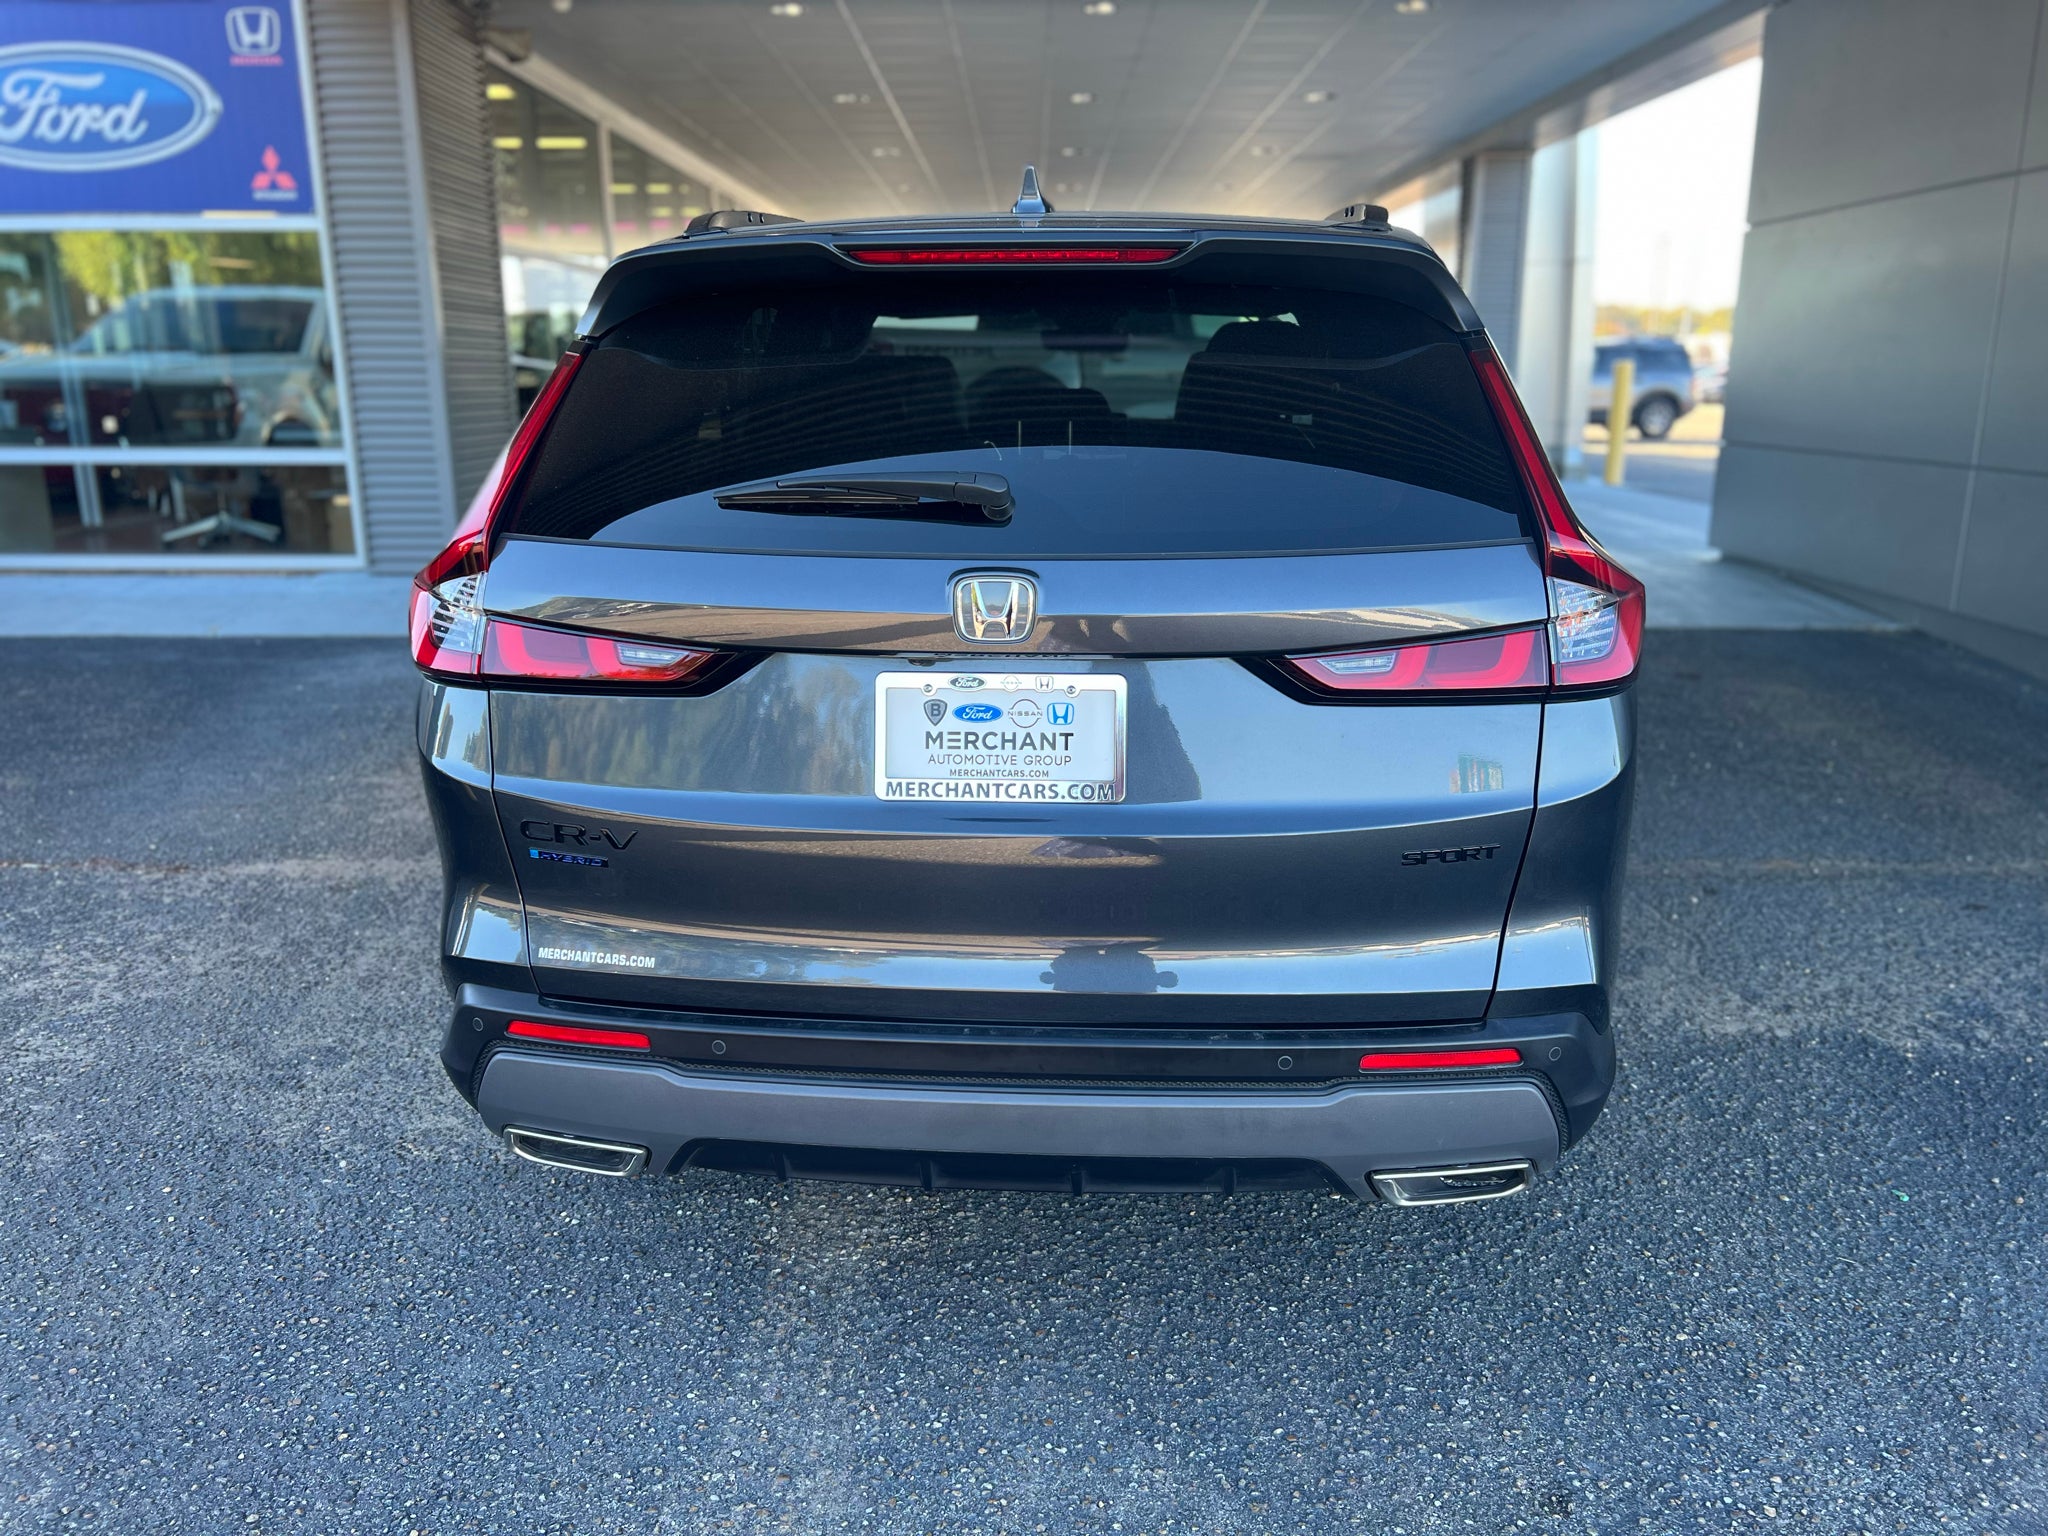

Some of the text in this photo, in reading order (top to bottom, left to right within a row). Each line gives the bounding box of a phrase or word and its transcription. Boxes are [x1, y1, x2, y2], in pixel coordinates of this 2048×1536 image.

[0, 69, 148, 143] Ford
[955, 676, 979, 688] Ford
[931, 703, 940, 716] B
[962, 705, 994, 720] Ford
[925, 731, 1074, 751] MERCHANT
[928, 754, 1072, 766] AUTOMOTIVE GROUP
[949, 768, 1049, 778] MERCHANTCARS.COM
[885, 782, 1115, 800] MERCHANTCARS.COM
[520, 819, 639, 850] CR-V
[1401, 844, 1501, 866] SPORT
[538, 947, 656, 969] MERCHANTCARS.COM
